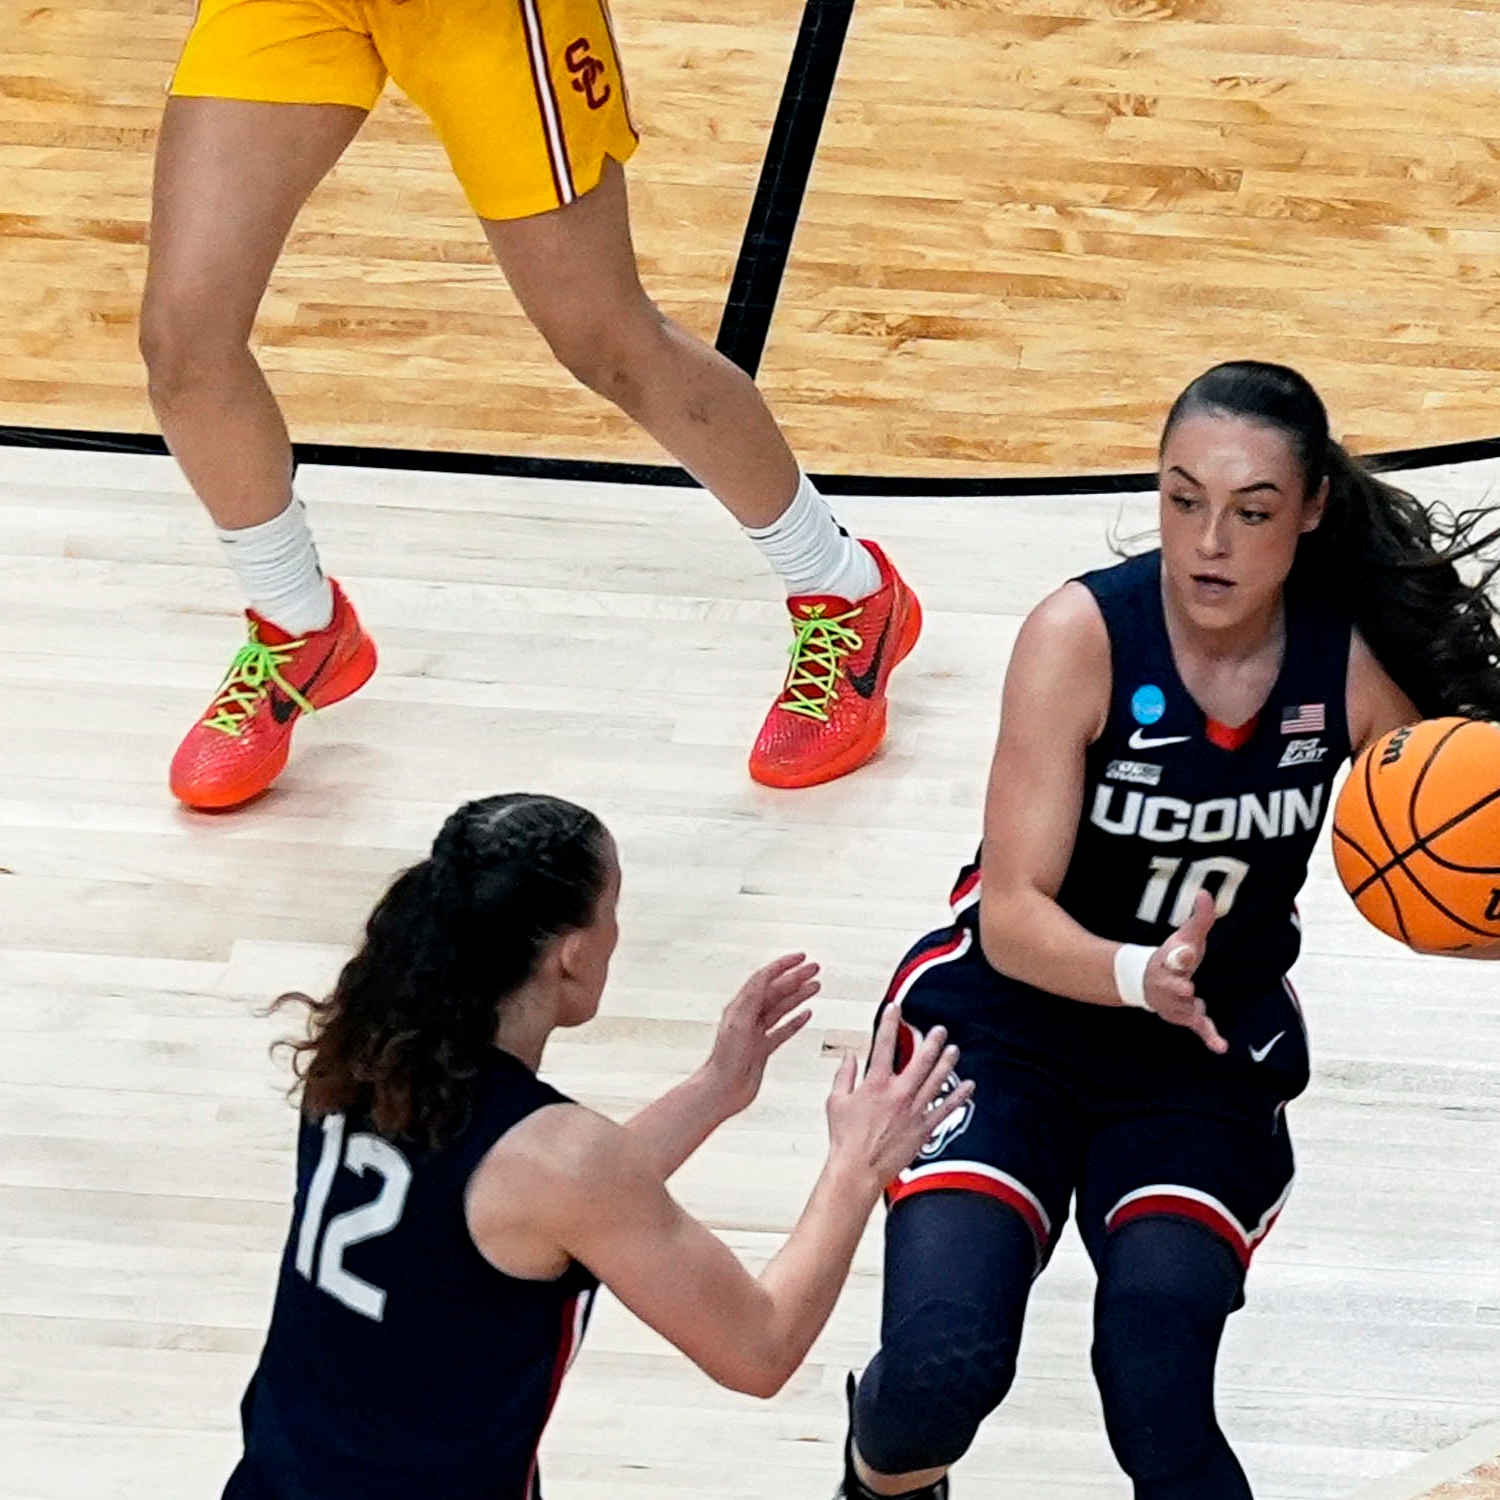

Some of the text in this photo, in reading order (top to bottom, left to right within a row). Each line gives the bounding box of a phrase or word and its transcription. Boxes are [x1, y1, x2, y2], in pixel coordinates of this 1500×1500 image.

[565, 37, 611, 110] SC
[1090, 783, 1324, 843] UCONN
[1136, 855, 1250, 928] 10
[296, 1112, 413, 1322] 12
